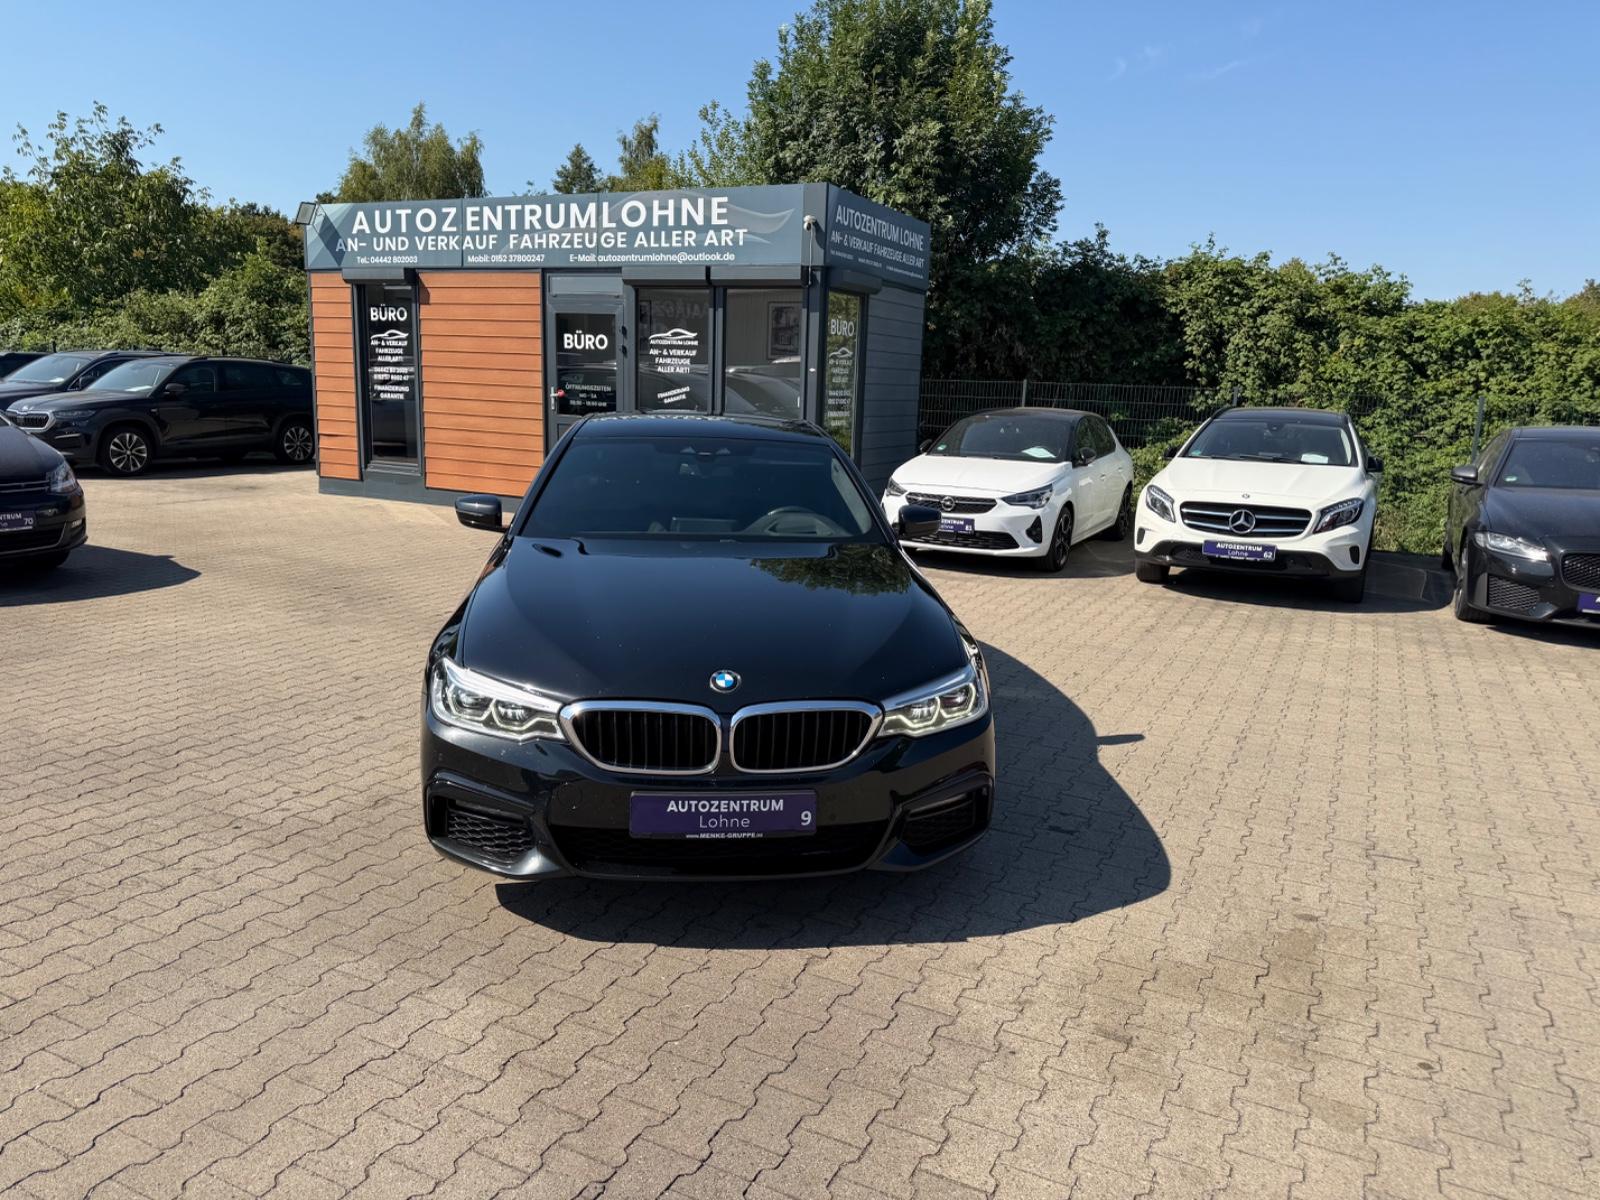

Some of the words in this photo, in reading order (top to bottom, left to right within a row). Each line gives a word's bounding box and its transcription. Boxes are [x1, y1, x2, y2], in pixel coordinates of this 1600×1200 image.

[835, 205, 899, 243] AUTOZENTRUM
[900, 227, 924, 251] LOHNE
[335, 237, 367, 252] AN-
[373, 236, 408, 250] UND
[415, 234, 498, 250] VERKAUF
[509, 231, 627, 249] FAHRZEUGE
[634, 229, 696, 248] ALLER
[704, 228, 748, 247] ART
[849, 235, 874, 253] VERKAUF
[874, 243, 903, 262] FAHRZEUGE
[597, 252, 735, 264] autozentrumlohne@outlook.de
[370, 304, 407, 321] BÜRO
[830, 315, 855, 336] BÜRO
[563, 330, 608, 349] BÜRO
[655, 357, 691, 365] FAHRZEUGE
[1216, 542, 1262, 551] AUTOZENTRUM
[1263, 551, 1273, 559] 62
[667, 799, 784, 812] AUTOZENTRUM
[699, 815, 750, 828] Lohne
[800, 811, 812, 826] 9
